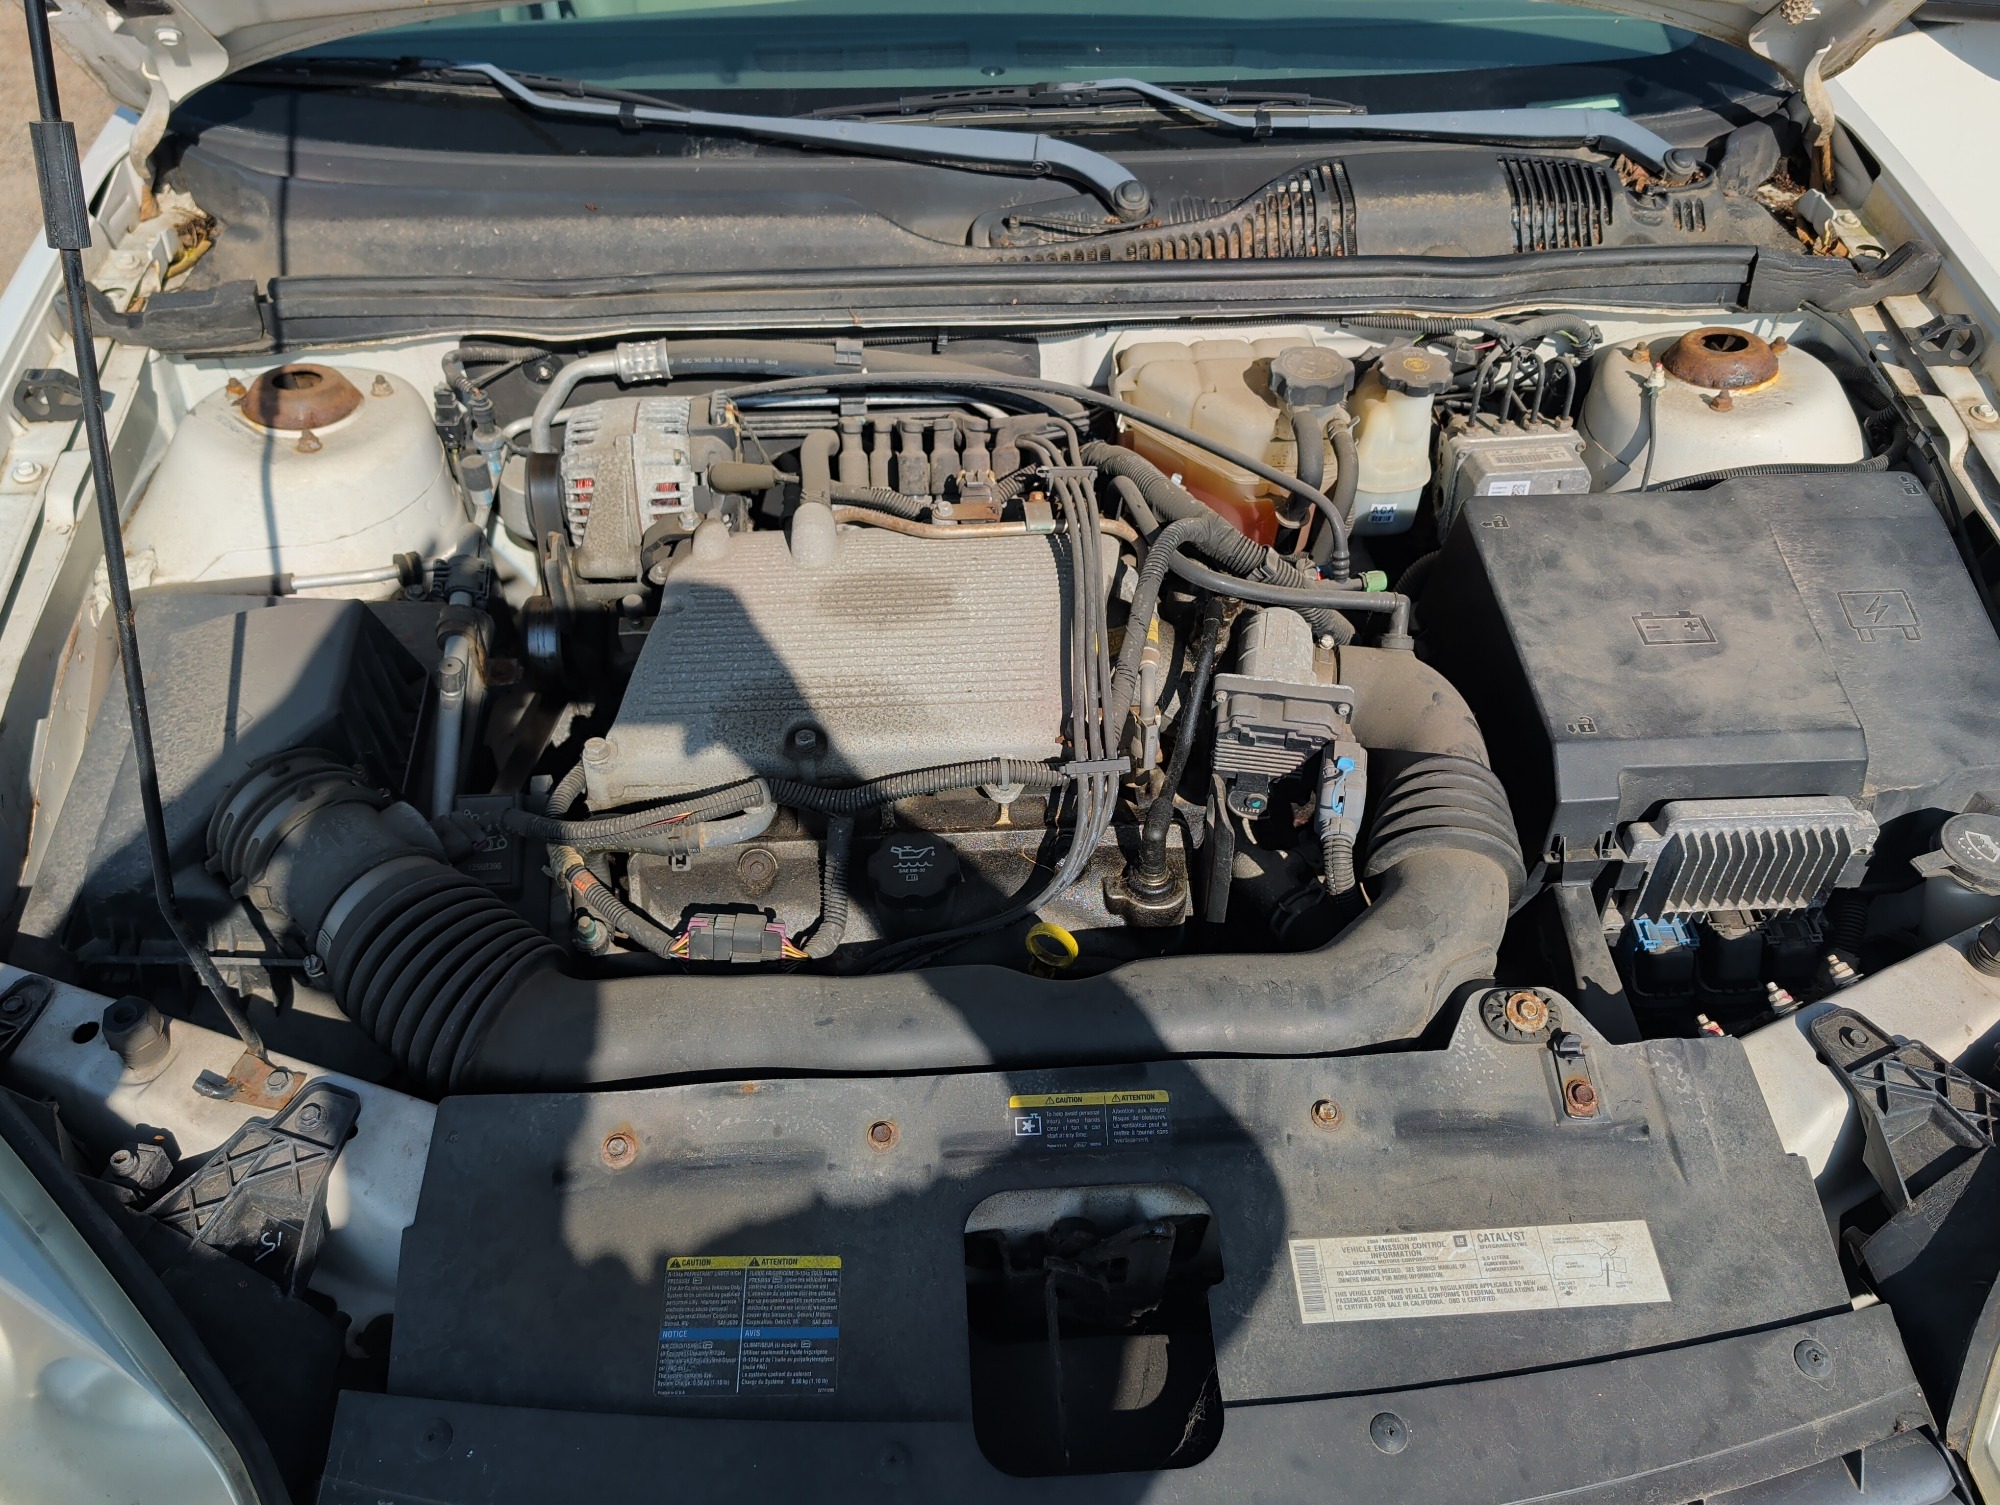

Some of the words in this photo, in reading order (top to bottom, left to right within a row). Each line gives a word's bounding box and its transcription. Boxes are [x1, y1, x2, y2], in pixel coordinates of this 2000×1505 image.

[1055, 1096, 1083, 1104] CAUTION
[1477, 1231, 1526, 1243] CATALYST
[1374, 1244, 1410, 1252] EMISSION
[1412, 1241, 1446, 1250] CONTROL
[1370, 1249, 1422, 1259] INFORMATION
[681, 1258, 712, 1267] CAUTION
[761, 1258, 798, 1266] ATTENTION
[1440, 1283, 1478, 1291] REGULATIONS
[1480, 1281, 1514, 1289] APPLICABLE
[1335, 1296, 1369, 1304] PASSENGER
[1430, 1291, 1460, 1299] CONFORMS
[662, 1330, 688, 1338] NOTICE
